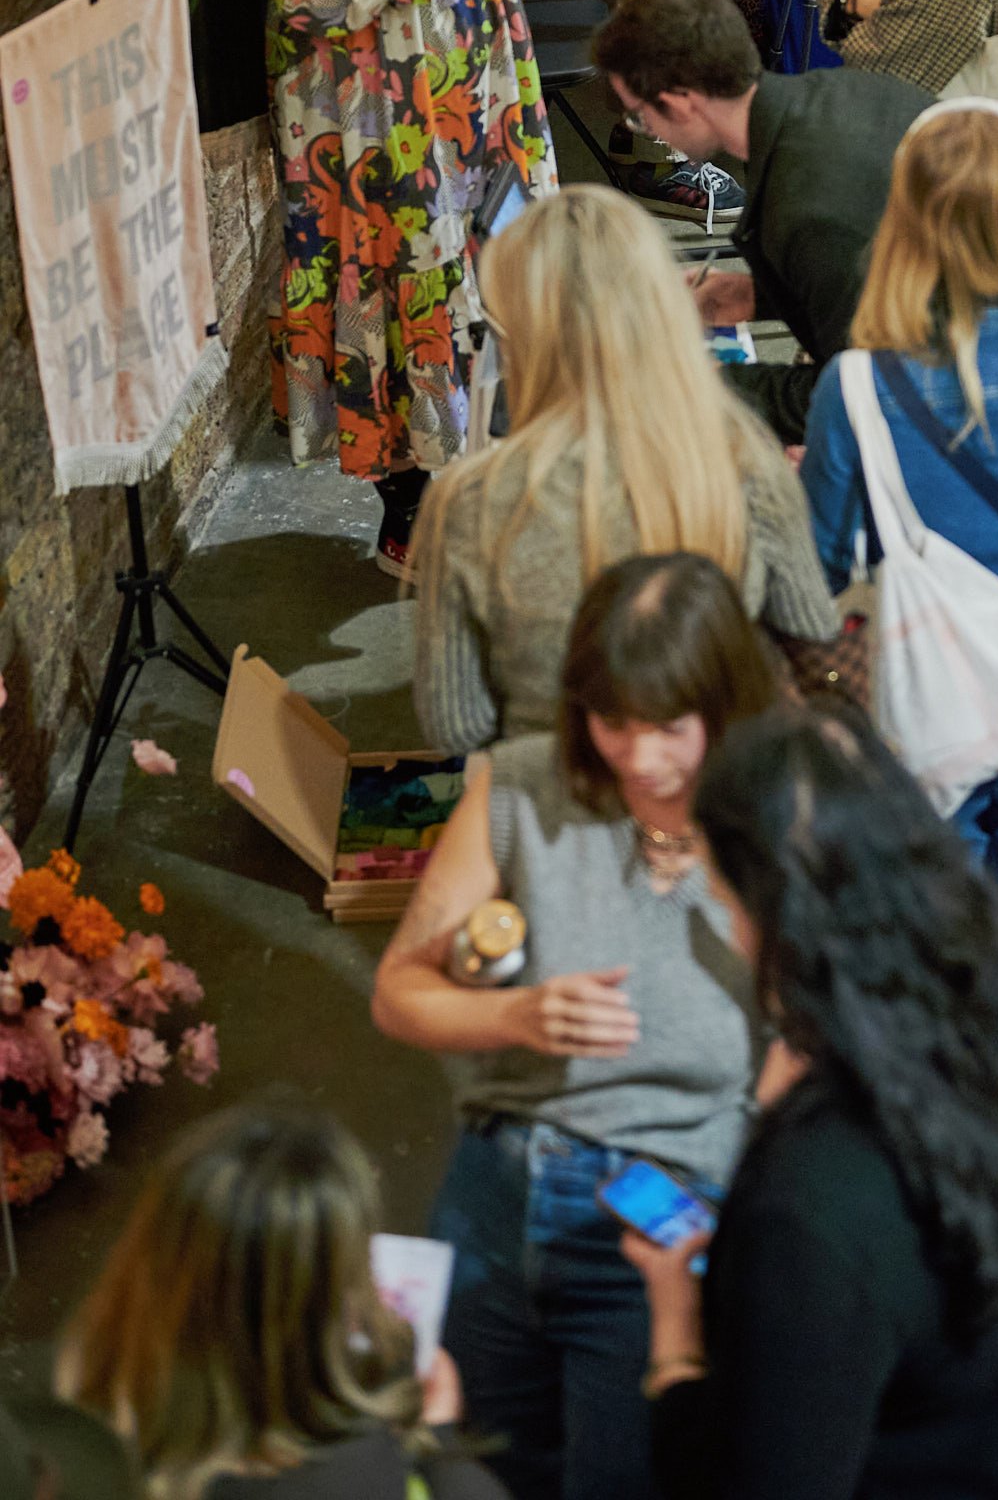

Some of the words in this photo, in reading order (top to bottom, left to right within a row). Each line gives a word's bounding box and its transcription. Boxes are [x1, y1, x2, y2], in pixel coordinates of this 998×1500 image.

[51, 22, 146, 126] THIS
[50, 103, 159, 225] MUST
[47, 238, 96, 323] BE
[120, 178, 182, 276] THE
[65, 272, 184, 399] PLACE
